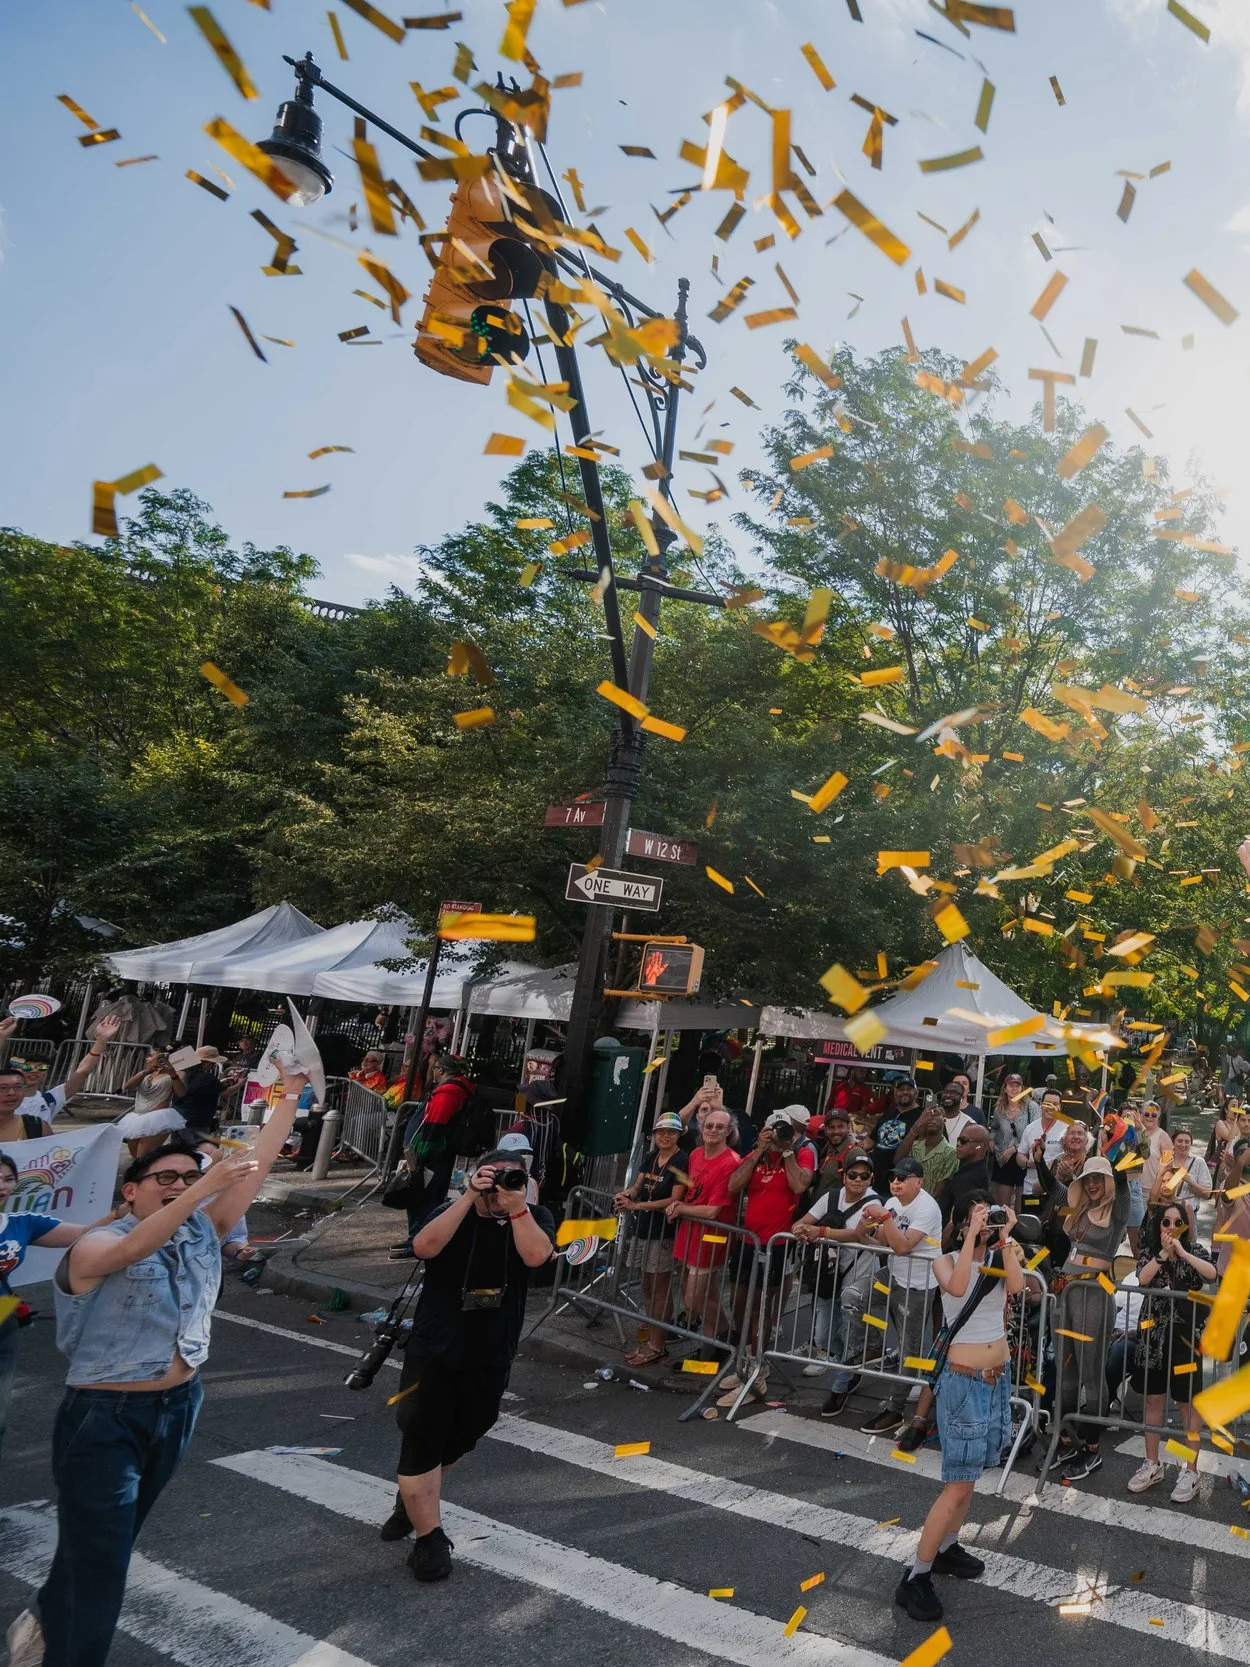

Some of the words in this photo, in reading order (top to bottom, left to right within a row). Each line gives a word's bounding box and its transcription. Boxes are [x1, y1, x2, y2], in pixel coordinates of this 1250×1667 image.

[565, 807, 572, 823] 7
[573, 807, 586, 823] Av
[644, 839, 654, 855] W
[656, 841, 668, 858] 12
[670, 844, 682, 860] St
[584, 877, 611, 894] ONE
[623, 883, 650, 899] WAY
[822, 1041, 858, 1058] MEDICAL
